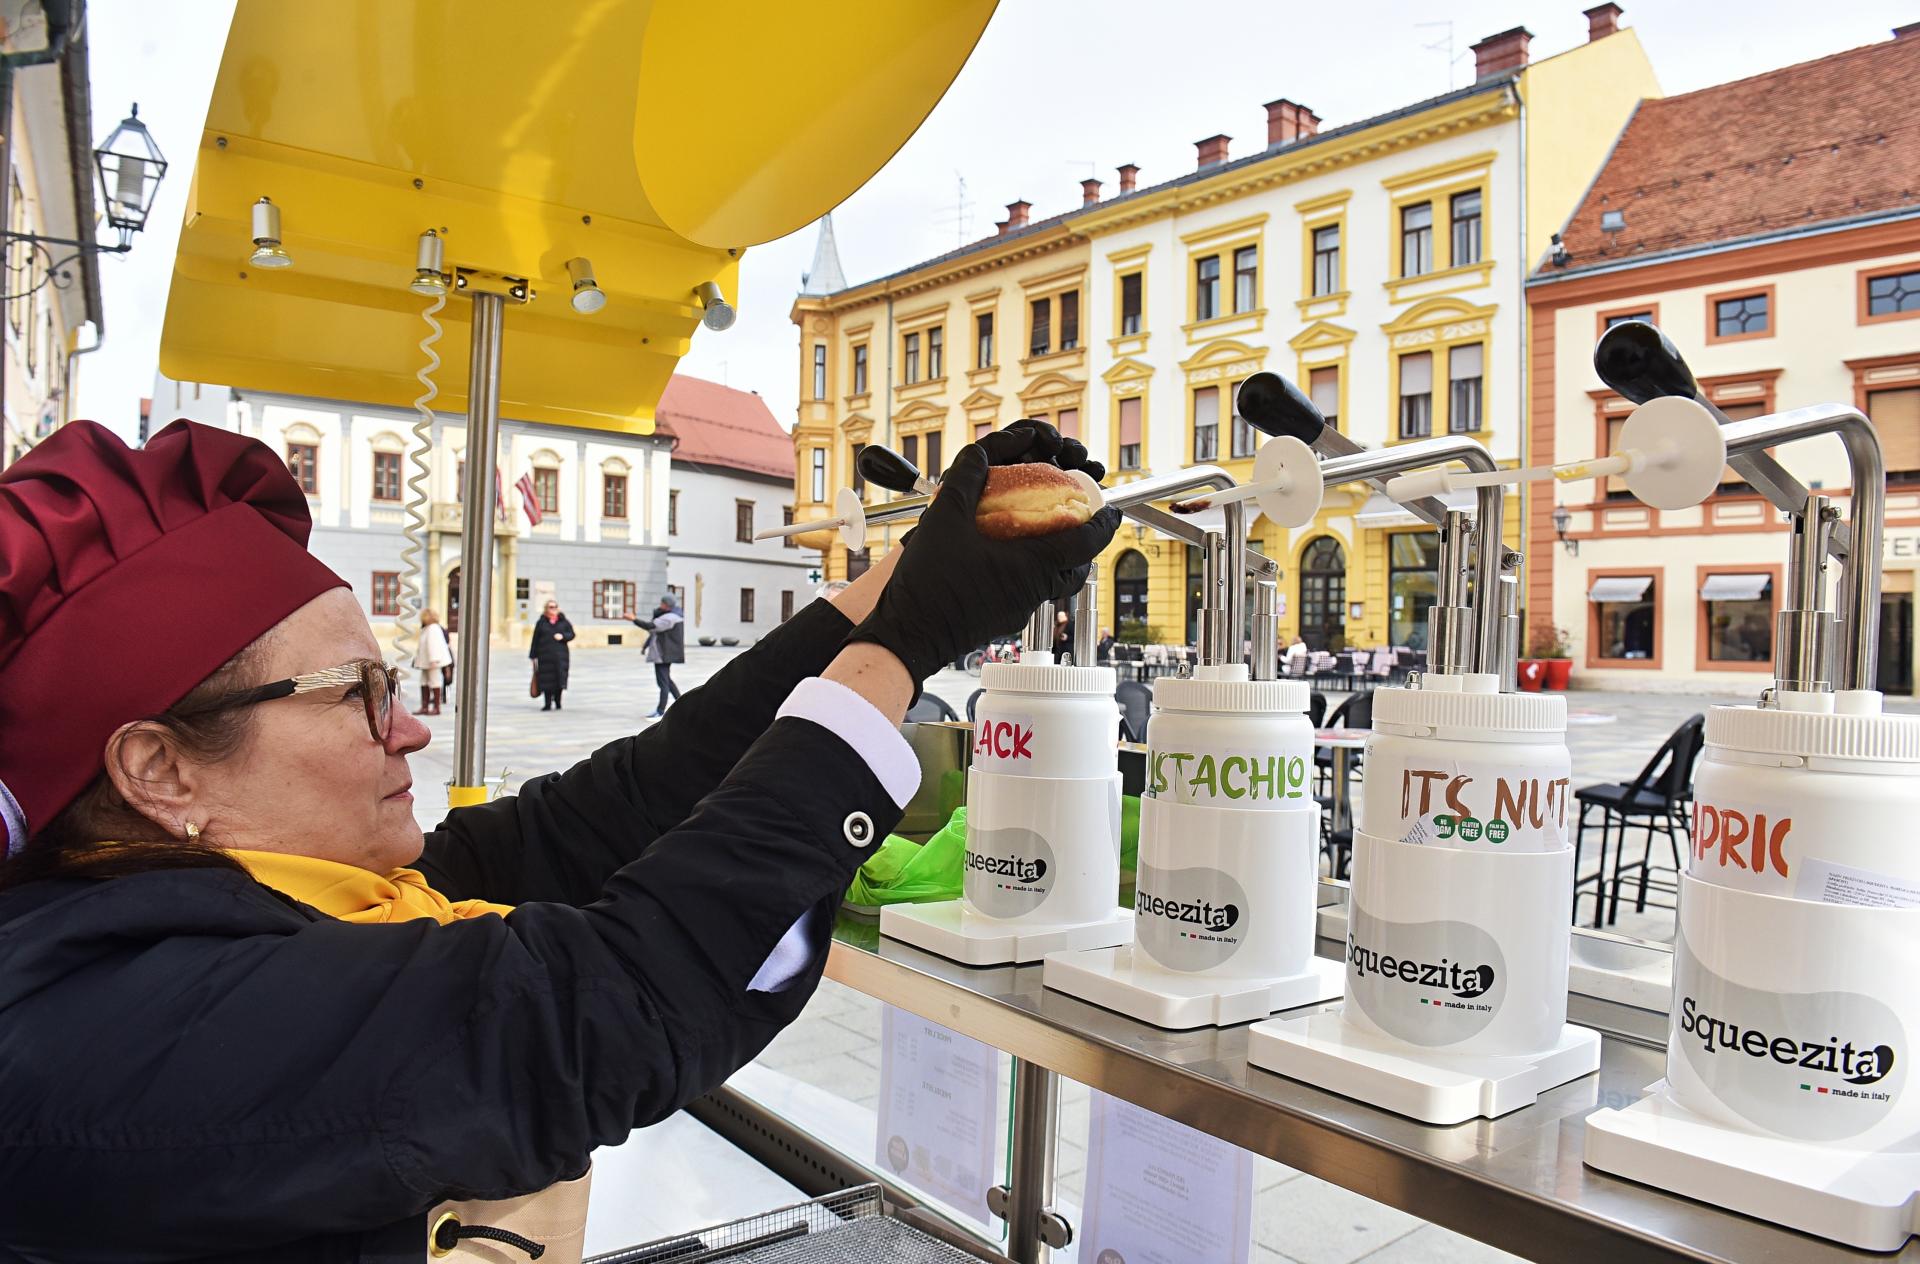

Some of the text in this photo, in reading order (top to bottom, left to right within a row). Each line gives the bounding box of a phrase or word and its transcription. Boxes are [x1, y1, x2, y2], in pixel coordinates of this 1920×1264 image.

[1461, 828, 1479, 837] FREE
[1489, 830, 1505, 839] FREE
[1348, 932, 1495, 998] Squeezita
[1444, 1001, 1466, 1010] made
[1476, 1004, 1492, 1012] italy
[1681, 997, 1895, 1085] Squeezita
[1832, 1088, 1890, 1102] made in italy
